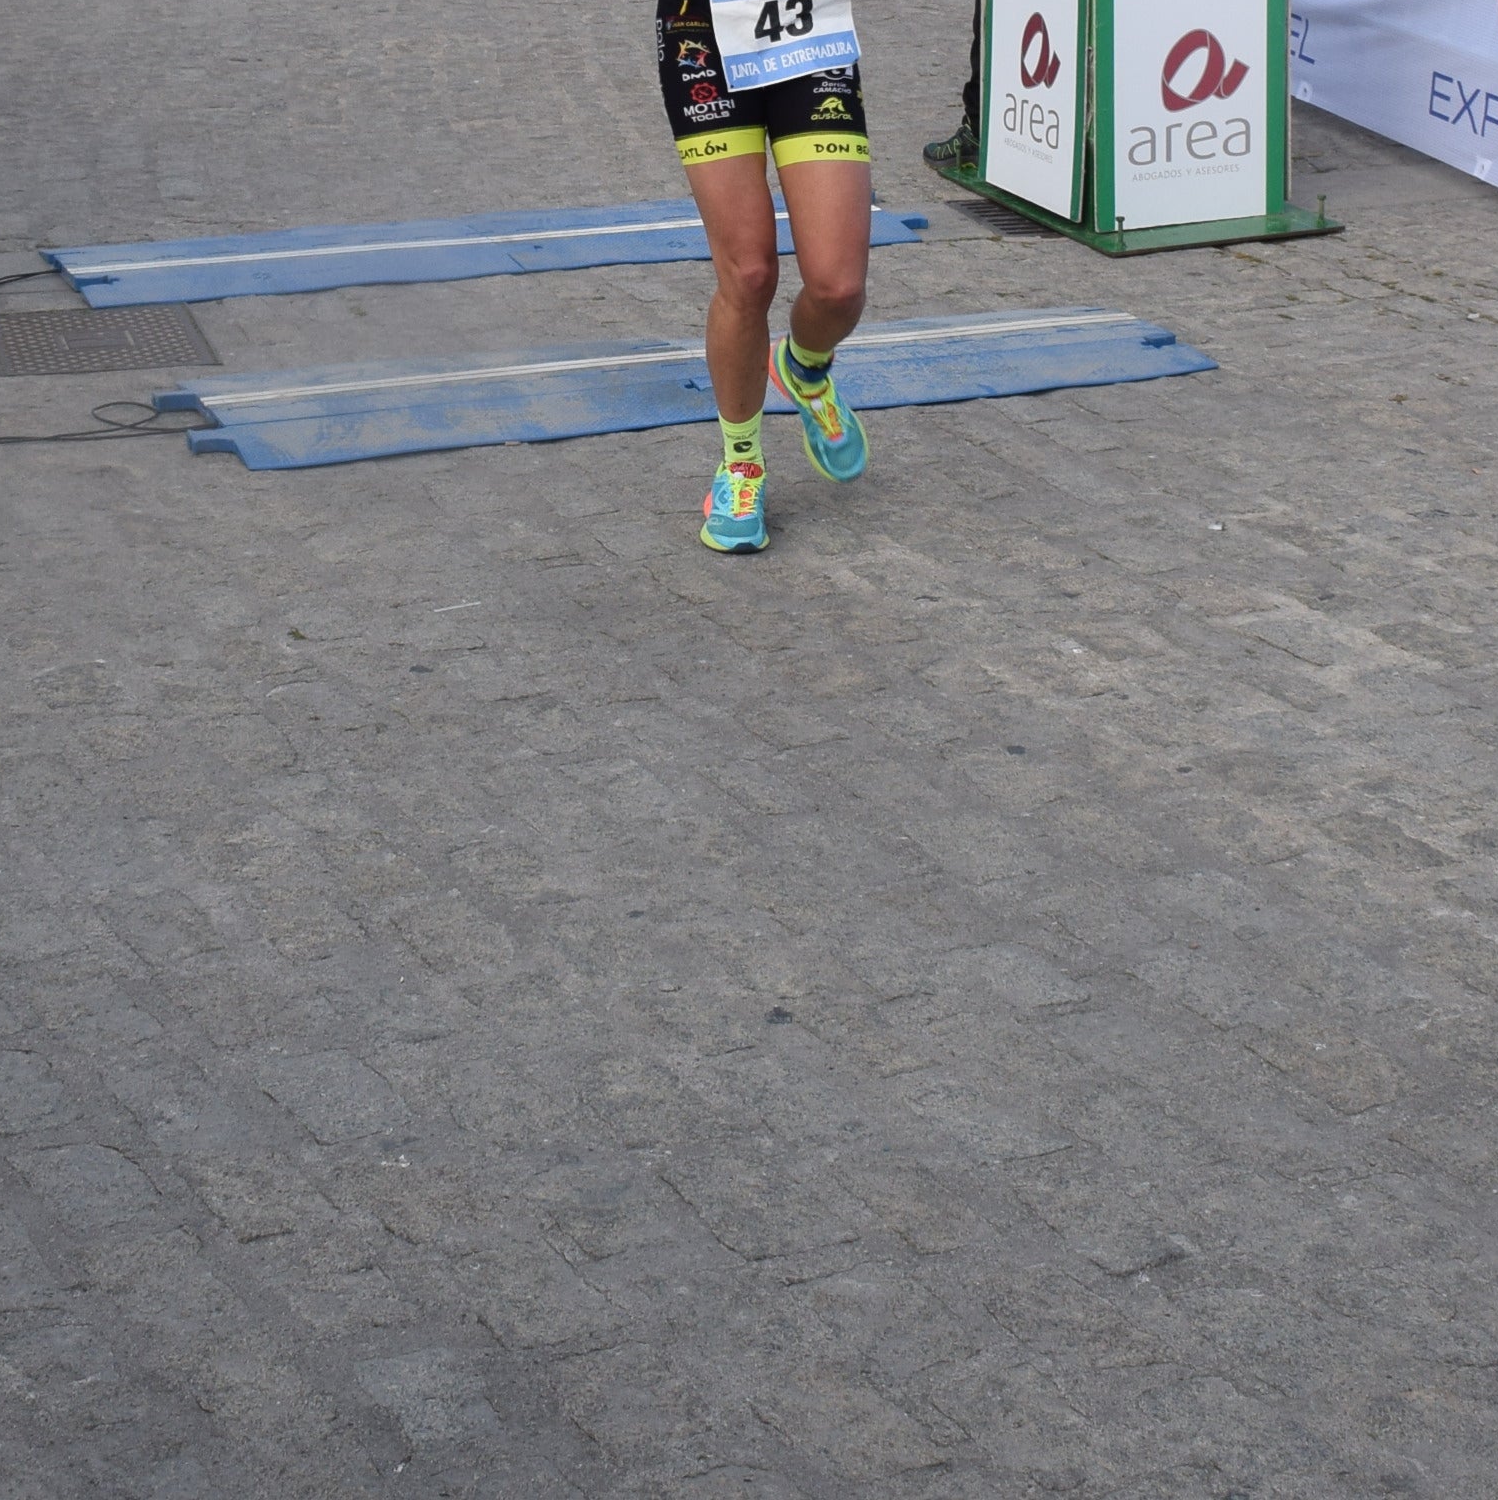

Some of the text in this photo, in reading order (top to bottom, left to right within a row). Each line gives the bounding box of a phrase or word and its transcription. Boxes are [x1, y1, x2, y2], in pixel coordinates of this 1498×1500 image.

[729, 40, 854, 82] JUNTA DE EXTREMADURA
[683, 98, 736, 117] MOTRI
[691, 111, 731, 123] TOOLS
[1003, 92, 1060, 150] area
[813, 142, 850, 154] DON
[1127, 116, 1252, 166] area
[1132, 163, 1241, 182] ABOGADOS Y ASESORES
